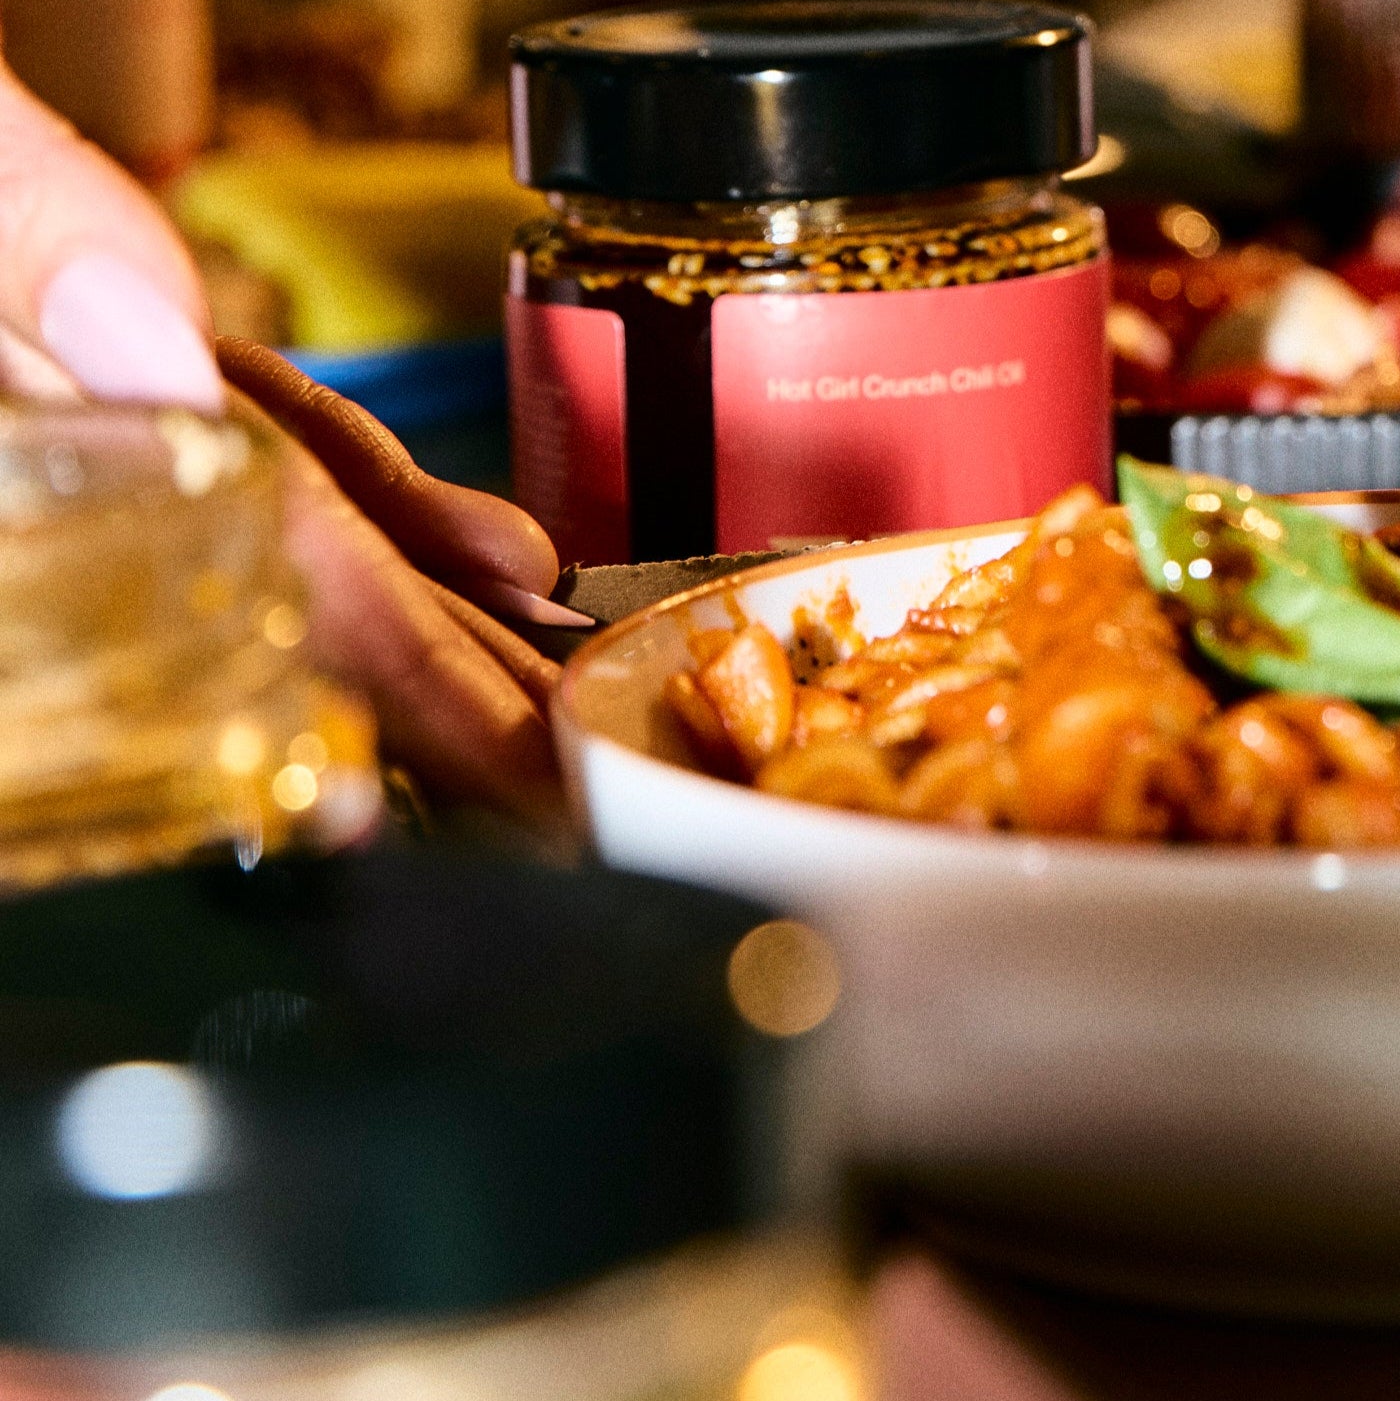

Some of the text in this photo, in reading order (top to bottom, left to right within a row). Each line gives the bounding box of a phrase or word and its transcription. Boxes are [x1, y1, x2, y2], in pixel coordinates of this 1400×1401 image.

[766, 377, 812, 401] Hot
[816, 376, 859, 400] Girl
[862, 371, 948, 400] Crunch
